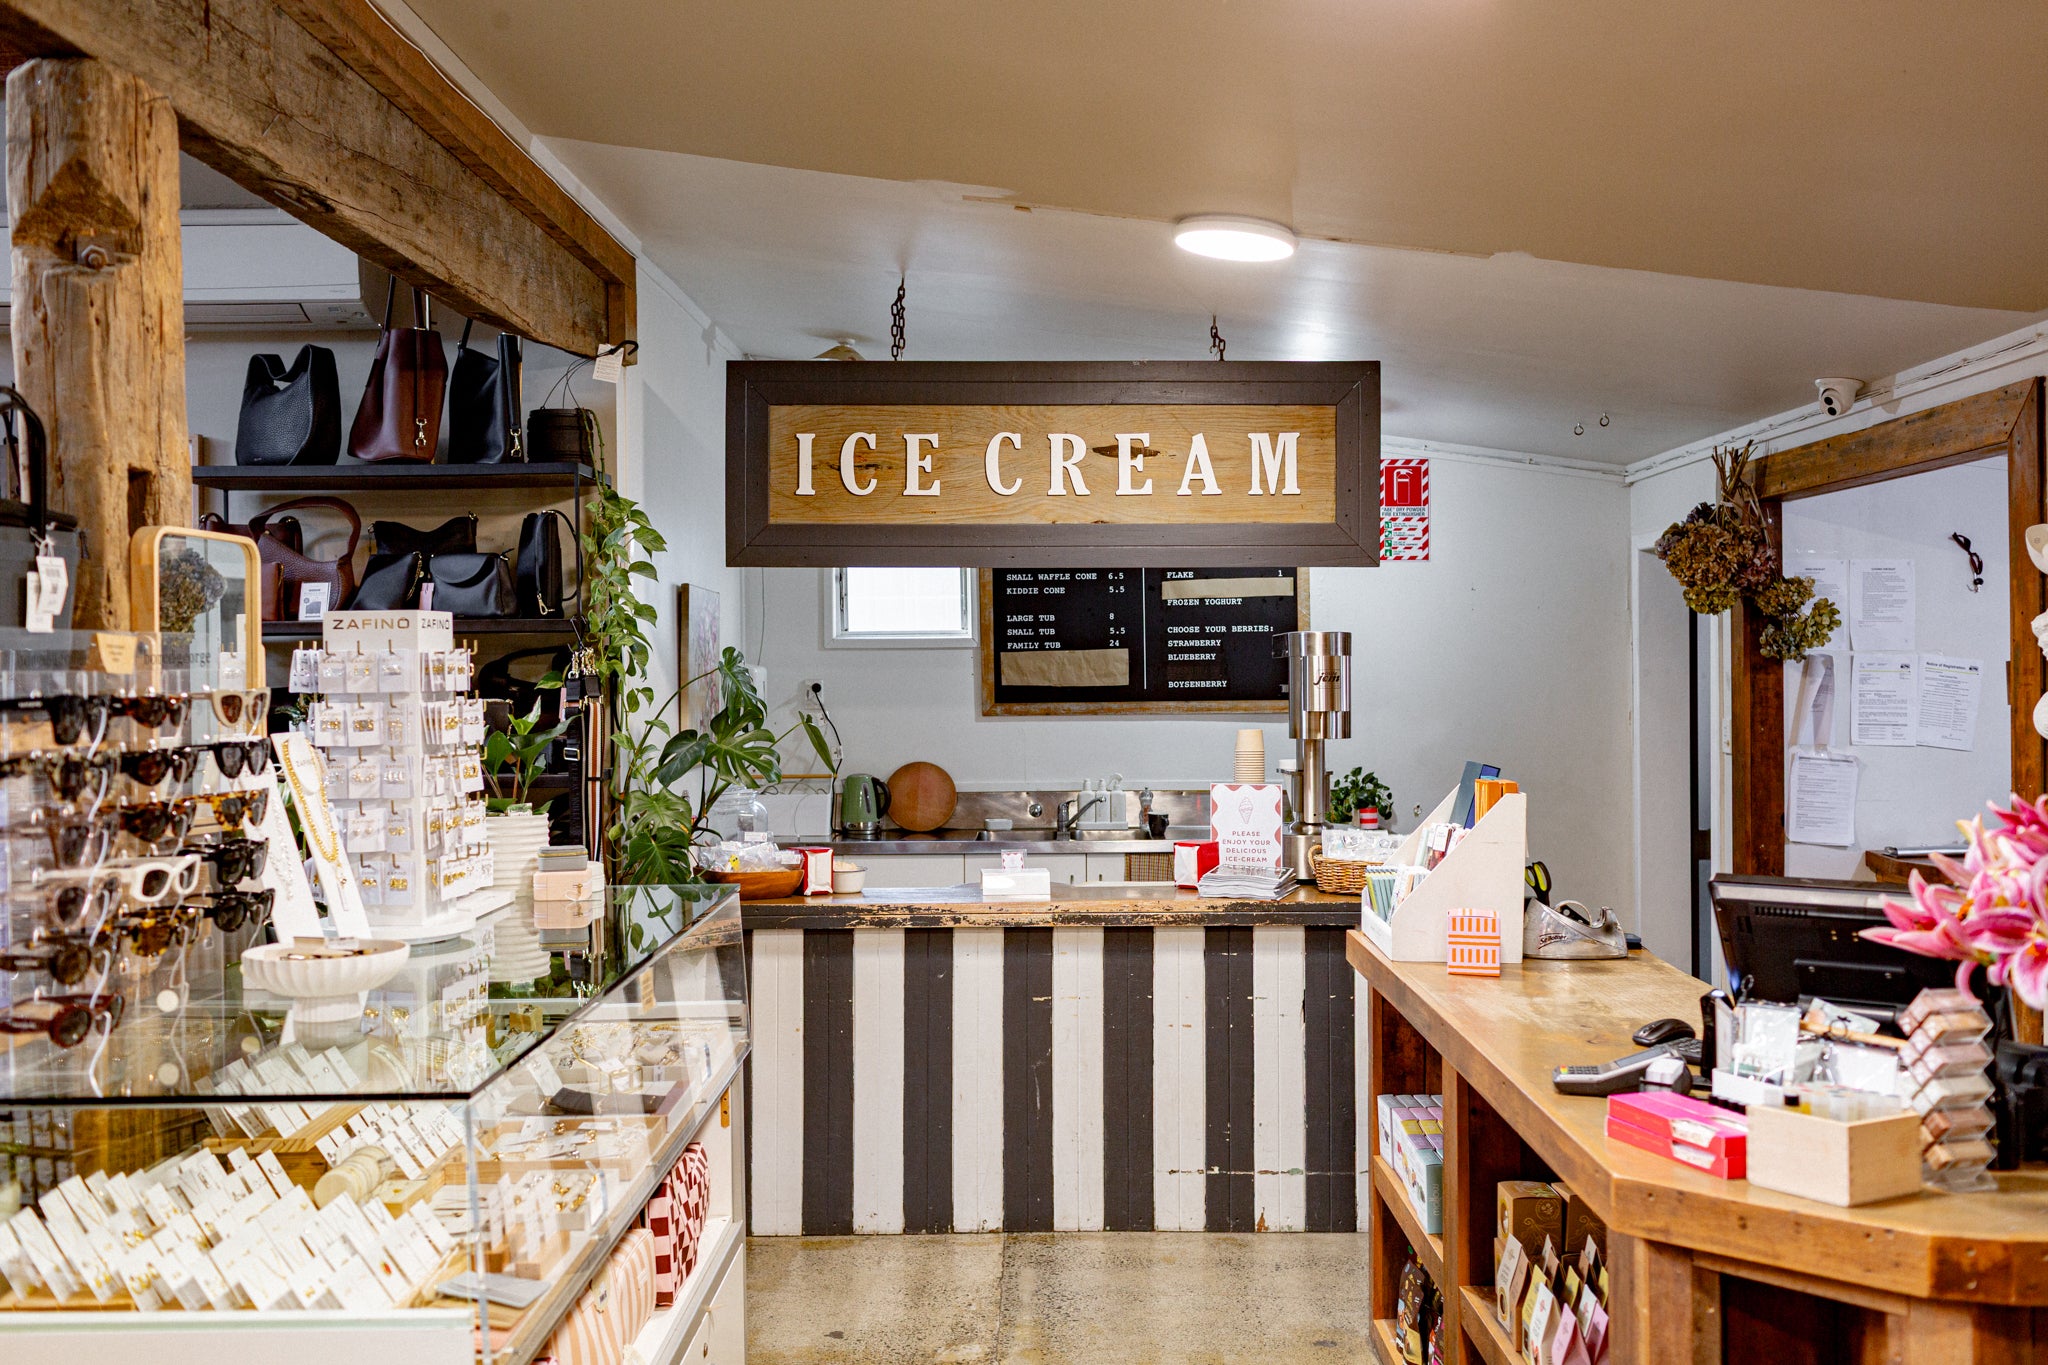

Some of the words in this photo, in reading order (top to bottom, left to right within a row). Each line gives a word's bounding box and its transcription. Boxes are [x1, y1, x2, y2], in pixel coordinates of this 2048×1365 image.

[795, 431, 941, 496] ICE
[985, 431, 1301, 496] CREAM
[1006, 573, 1034, 581] SMALL
[1075, 572, 1098, 580] CONE
[1108, 572, 1124, 580] 6.5
[1166, 571, 1194, 579] FLAKE
[1277, 569, 1283, 577] 1
[1006, 587, 1039, 595] KIDDIE
[1043, 586, 1066, 594] CONE
[1108, 585, 1125, 593] 5.5
[1167, 598, 1200, 606] FROZEN
[1006, 614, 1034, 622] LARGE
[1038, 614, 1056, 622] TUB
[1108, 612, 1115, 620] 8
[333, 617, 410, 630] ZAFINO
[421, 618, 450, 630] ZAFINO
[1006, 628, 1035, 636] SMALL
[1167, 626, 1200, 634] CHOOSE
[1204, 625, 1227, 633] YOUR
[1231, 625, 1274, 633] BERRIES:
[1044, 641, 1061, 649] TUB
[1109, 639, 1120, 647] 24
[1167, 639, 1222, 647] STRAWBERRY
[1167, 653, 1217, 661] BLUEBERRY
[1168, 680, 1228, 688] BOYSENBERRY
[1225, 855, 1268, 863] ICE-CREAM
